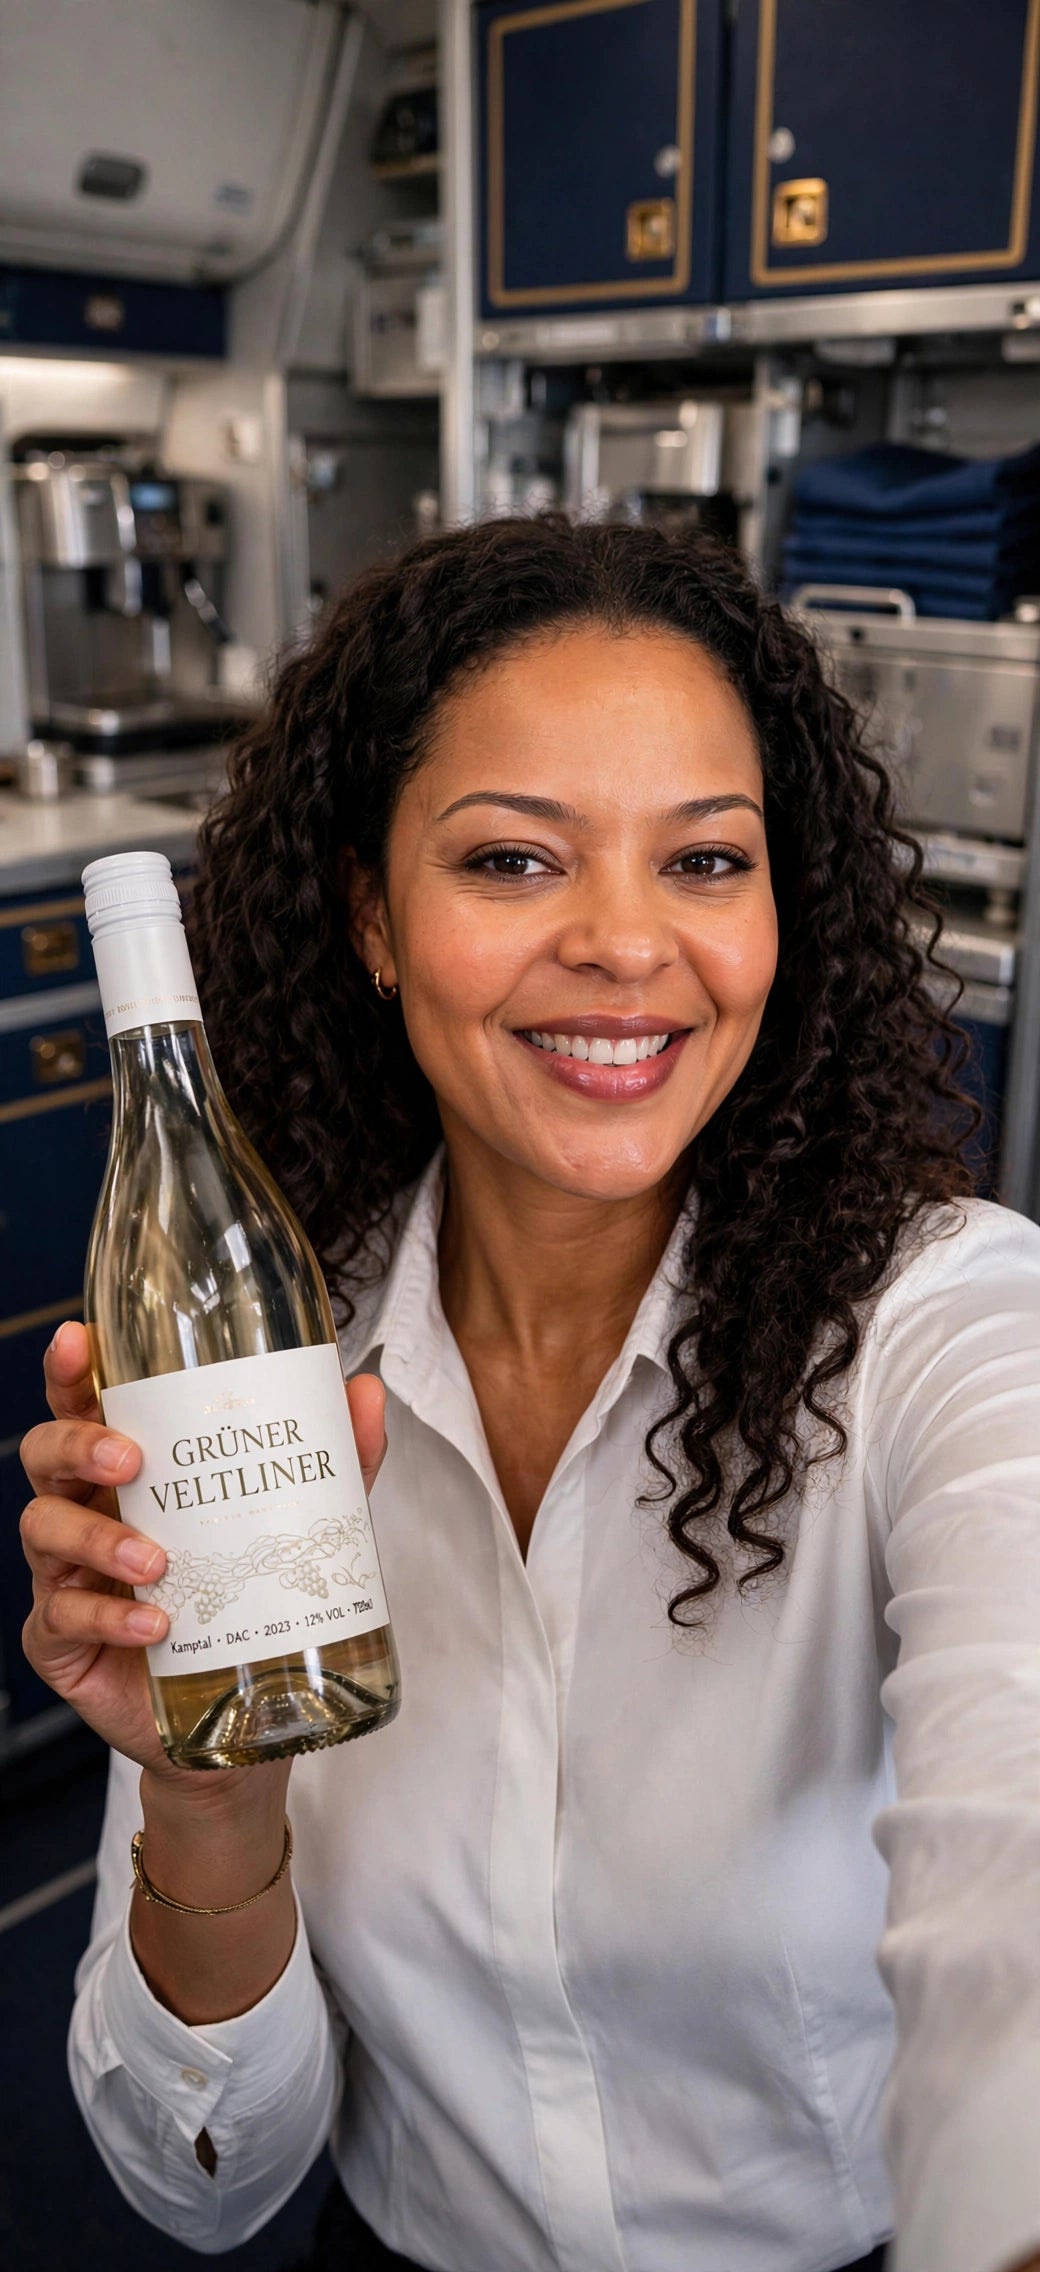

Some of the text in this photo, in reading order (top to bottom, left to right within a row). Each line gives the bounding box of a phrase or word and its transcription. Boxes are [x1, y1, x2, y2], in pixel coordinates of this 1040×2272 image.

[172, 1418, 304, 1467] GRÜNER
[149, 1450, 336, 1513] VELTLINER
[171, 1635, 212, 1654] Kamptal
[226, 1629, 250, 1645] DAC
[264, 1620, 291, 1636] 2023
[304, 1612, 324, 1627] 12%
[325, 1606, 345, 1621] VOL
